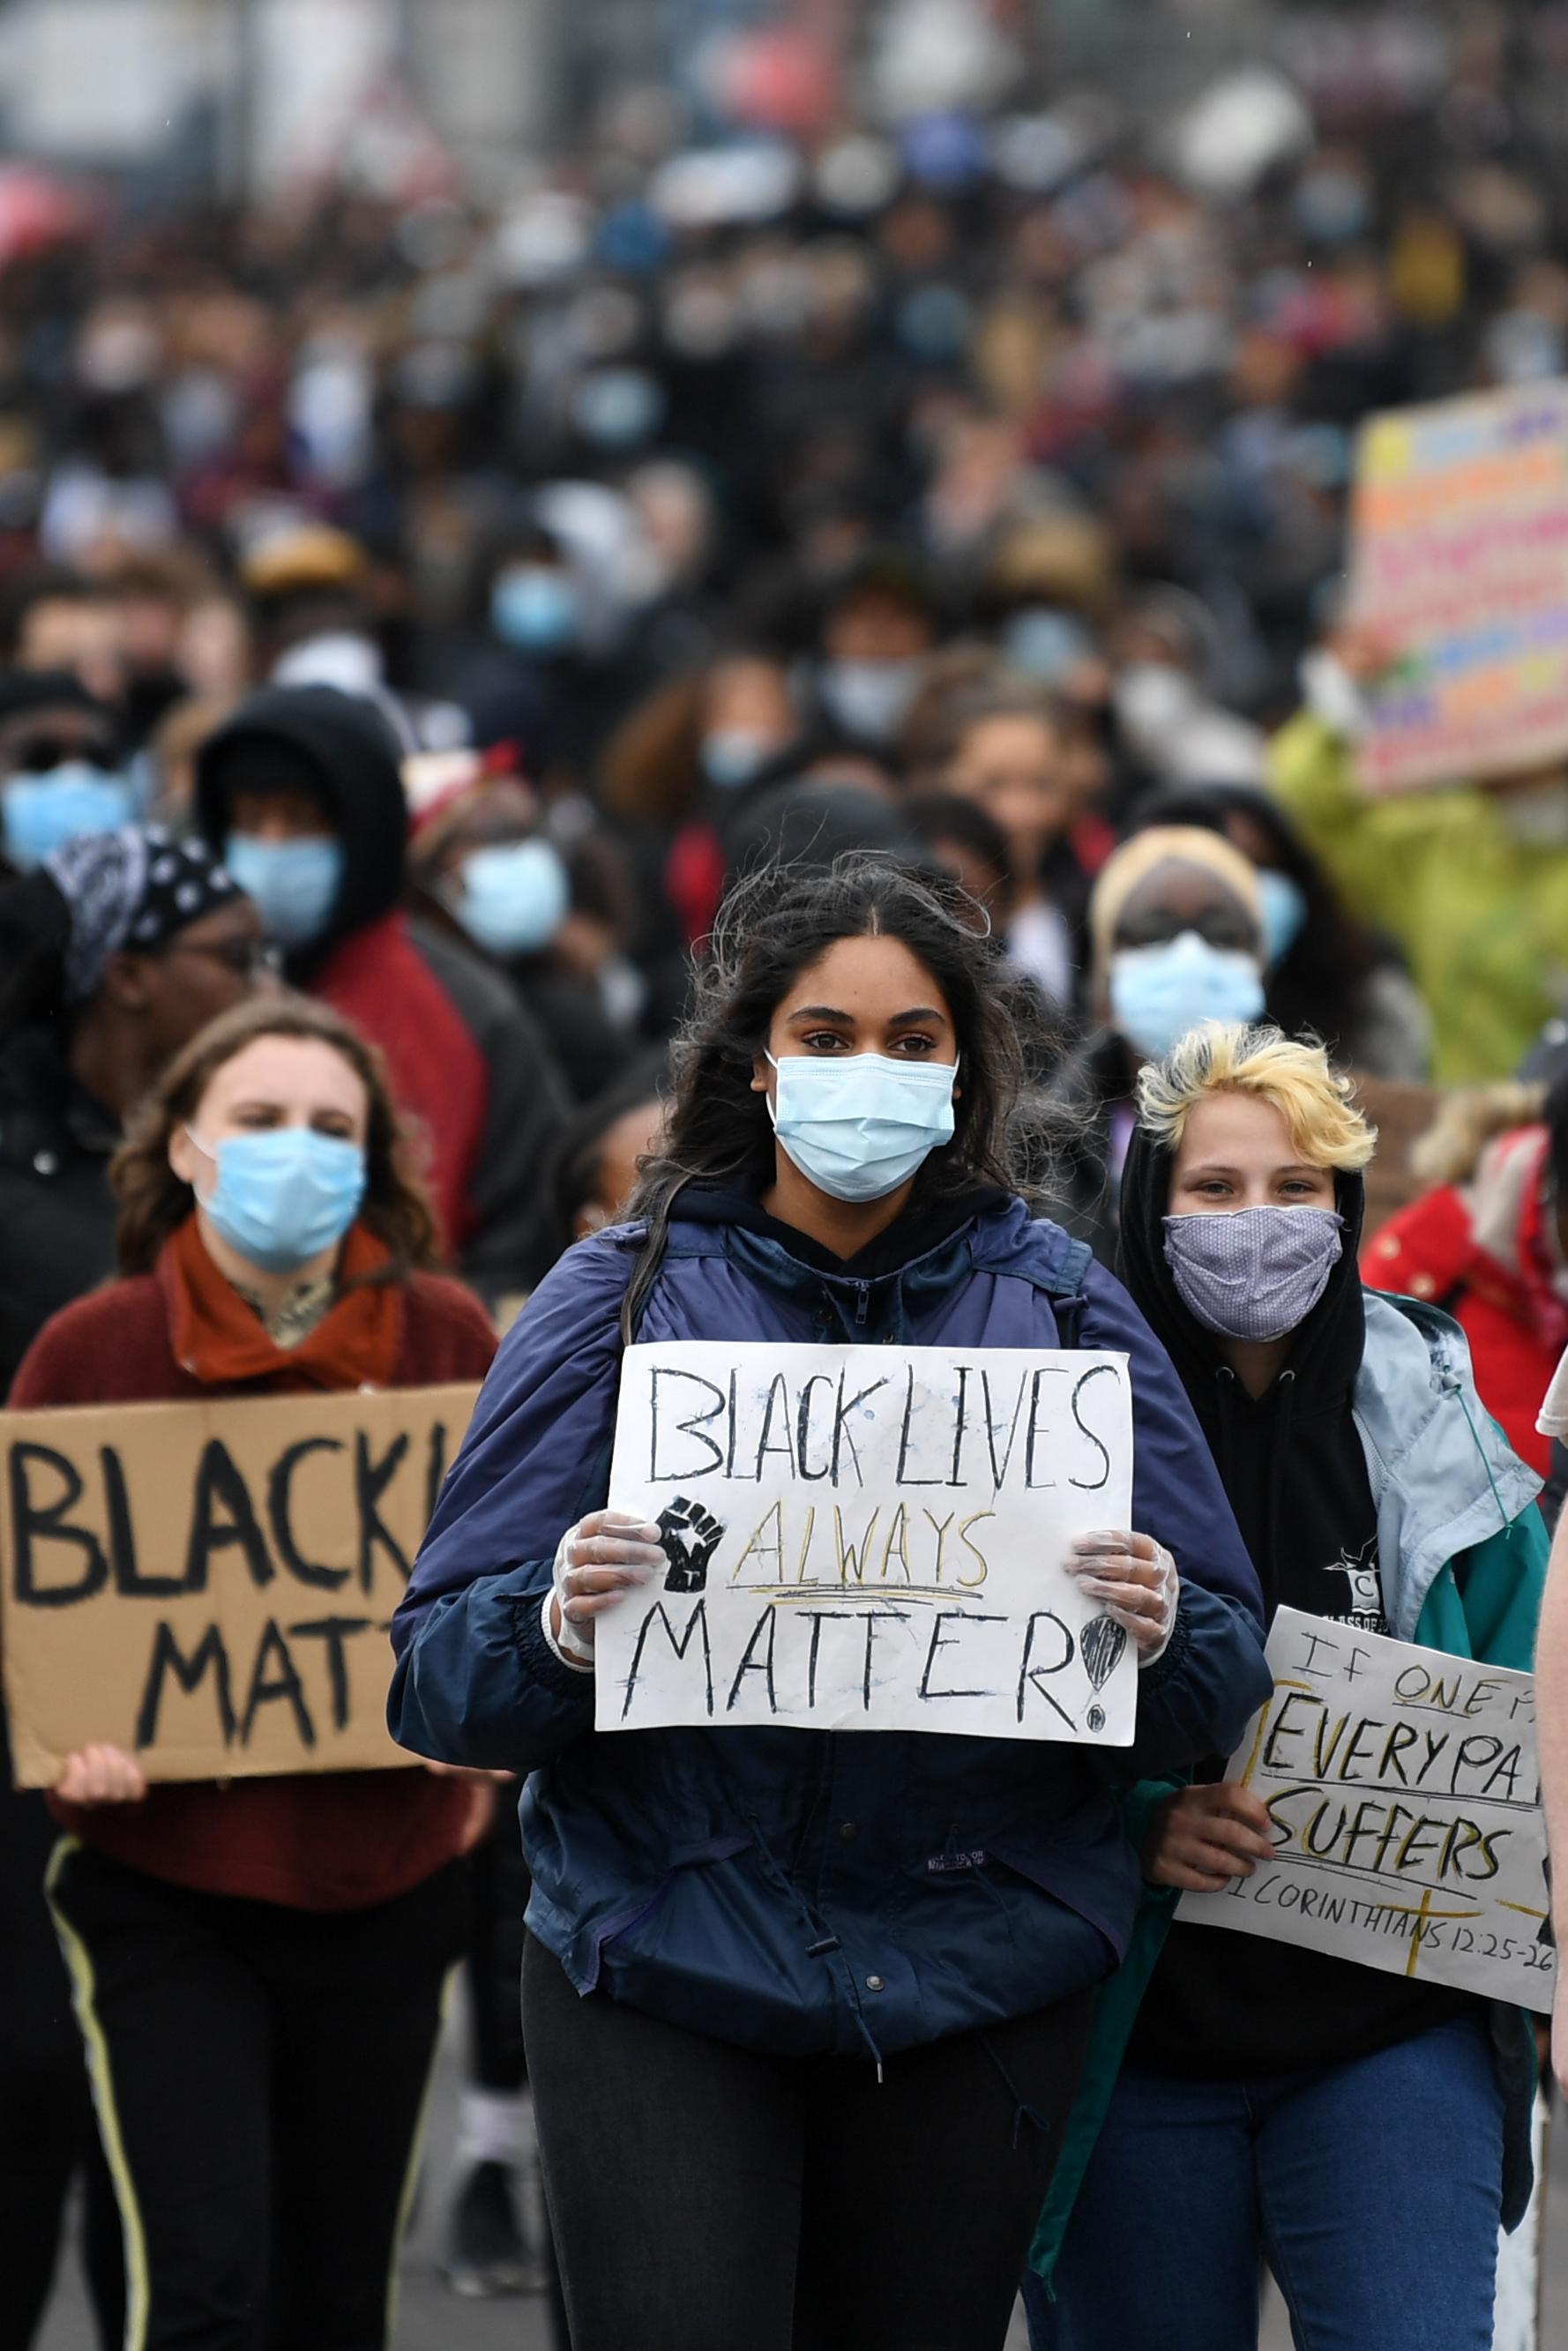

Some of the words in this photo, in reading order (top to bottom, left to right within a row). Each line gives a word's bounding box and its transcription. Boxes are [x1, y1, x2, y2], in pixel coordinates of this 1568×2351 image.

[644, 1363, 889, 1489] BLACK
[897, 1363, 1121, 1490] LIVES
[8, 1429, 416, 1607] BLACK
[732, 1501, 997, 1586] ALWAYS
[137, 1619, 392, 1749] MAT
[621, 1599, 1127, 1733] MATTER!
[1292, 1631, 1371, 1682] IF
[1394, 1665, 1503, 1713] ONE
[1263, 1692, 1449, 1785] EVERY
[1451, 1735, 1540, 1806] PA
[1265, 1787, 1513, 1879] SUFFERS
[1253, 1875, 1448, 1949] CORINTHIANS
[1452, 1926, 1553, 1971] 12:25-26
